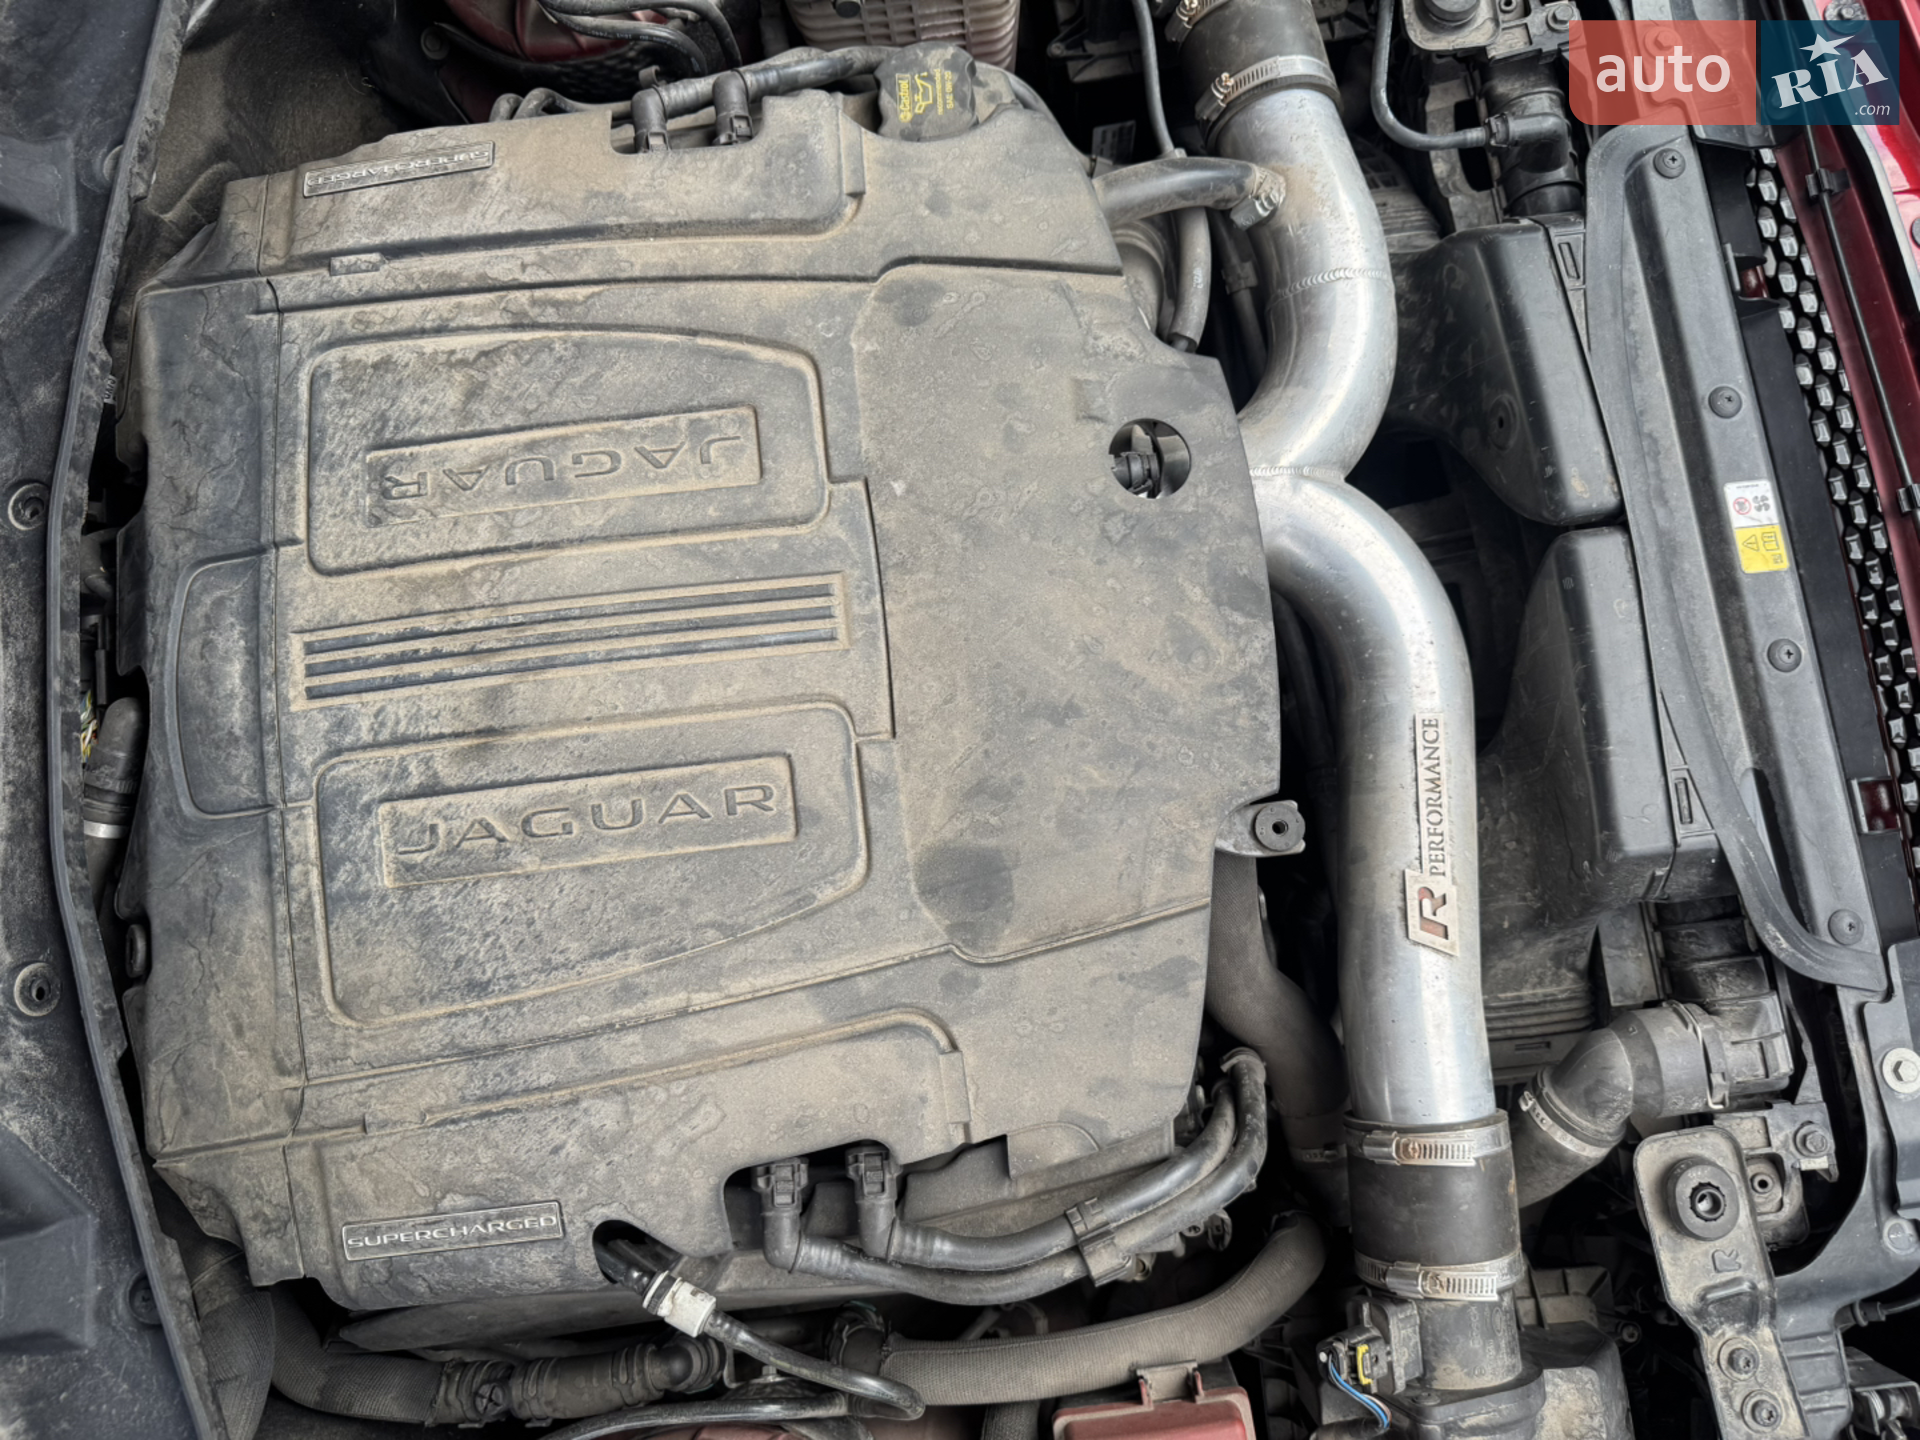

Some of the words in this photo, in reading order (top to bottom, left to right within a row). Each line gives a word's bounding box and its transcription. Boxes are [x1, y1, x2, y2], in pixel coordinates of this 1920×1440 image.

[897, 78, 911, 113] Castrol
[933, 68, 944, 115] recommended
[945, 93, 954, 110] SAE
[306, 150, 490, 187] SUPERCHARGED
[381, 434, 742, 501] JAGUAR
[397, 783, 775, 857] JAGUAR
[1421, 717, 1447, 877] PERFORMANCE
[1417, 886, 1449, 941] R
[346, 1215, 558, 1249] SUPERCHARGED
